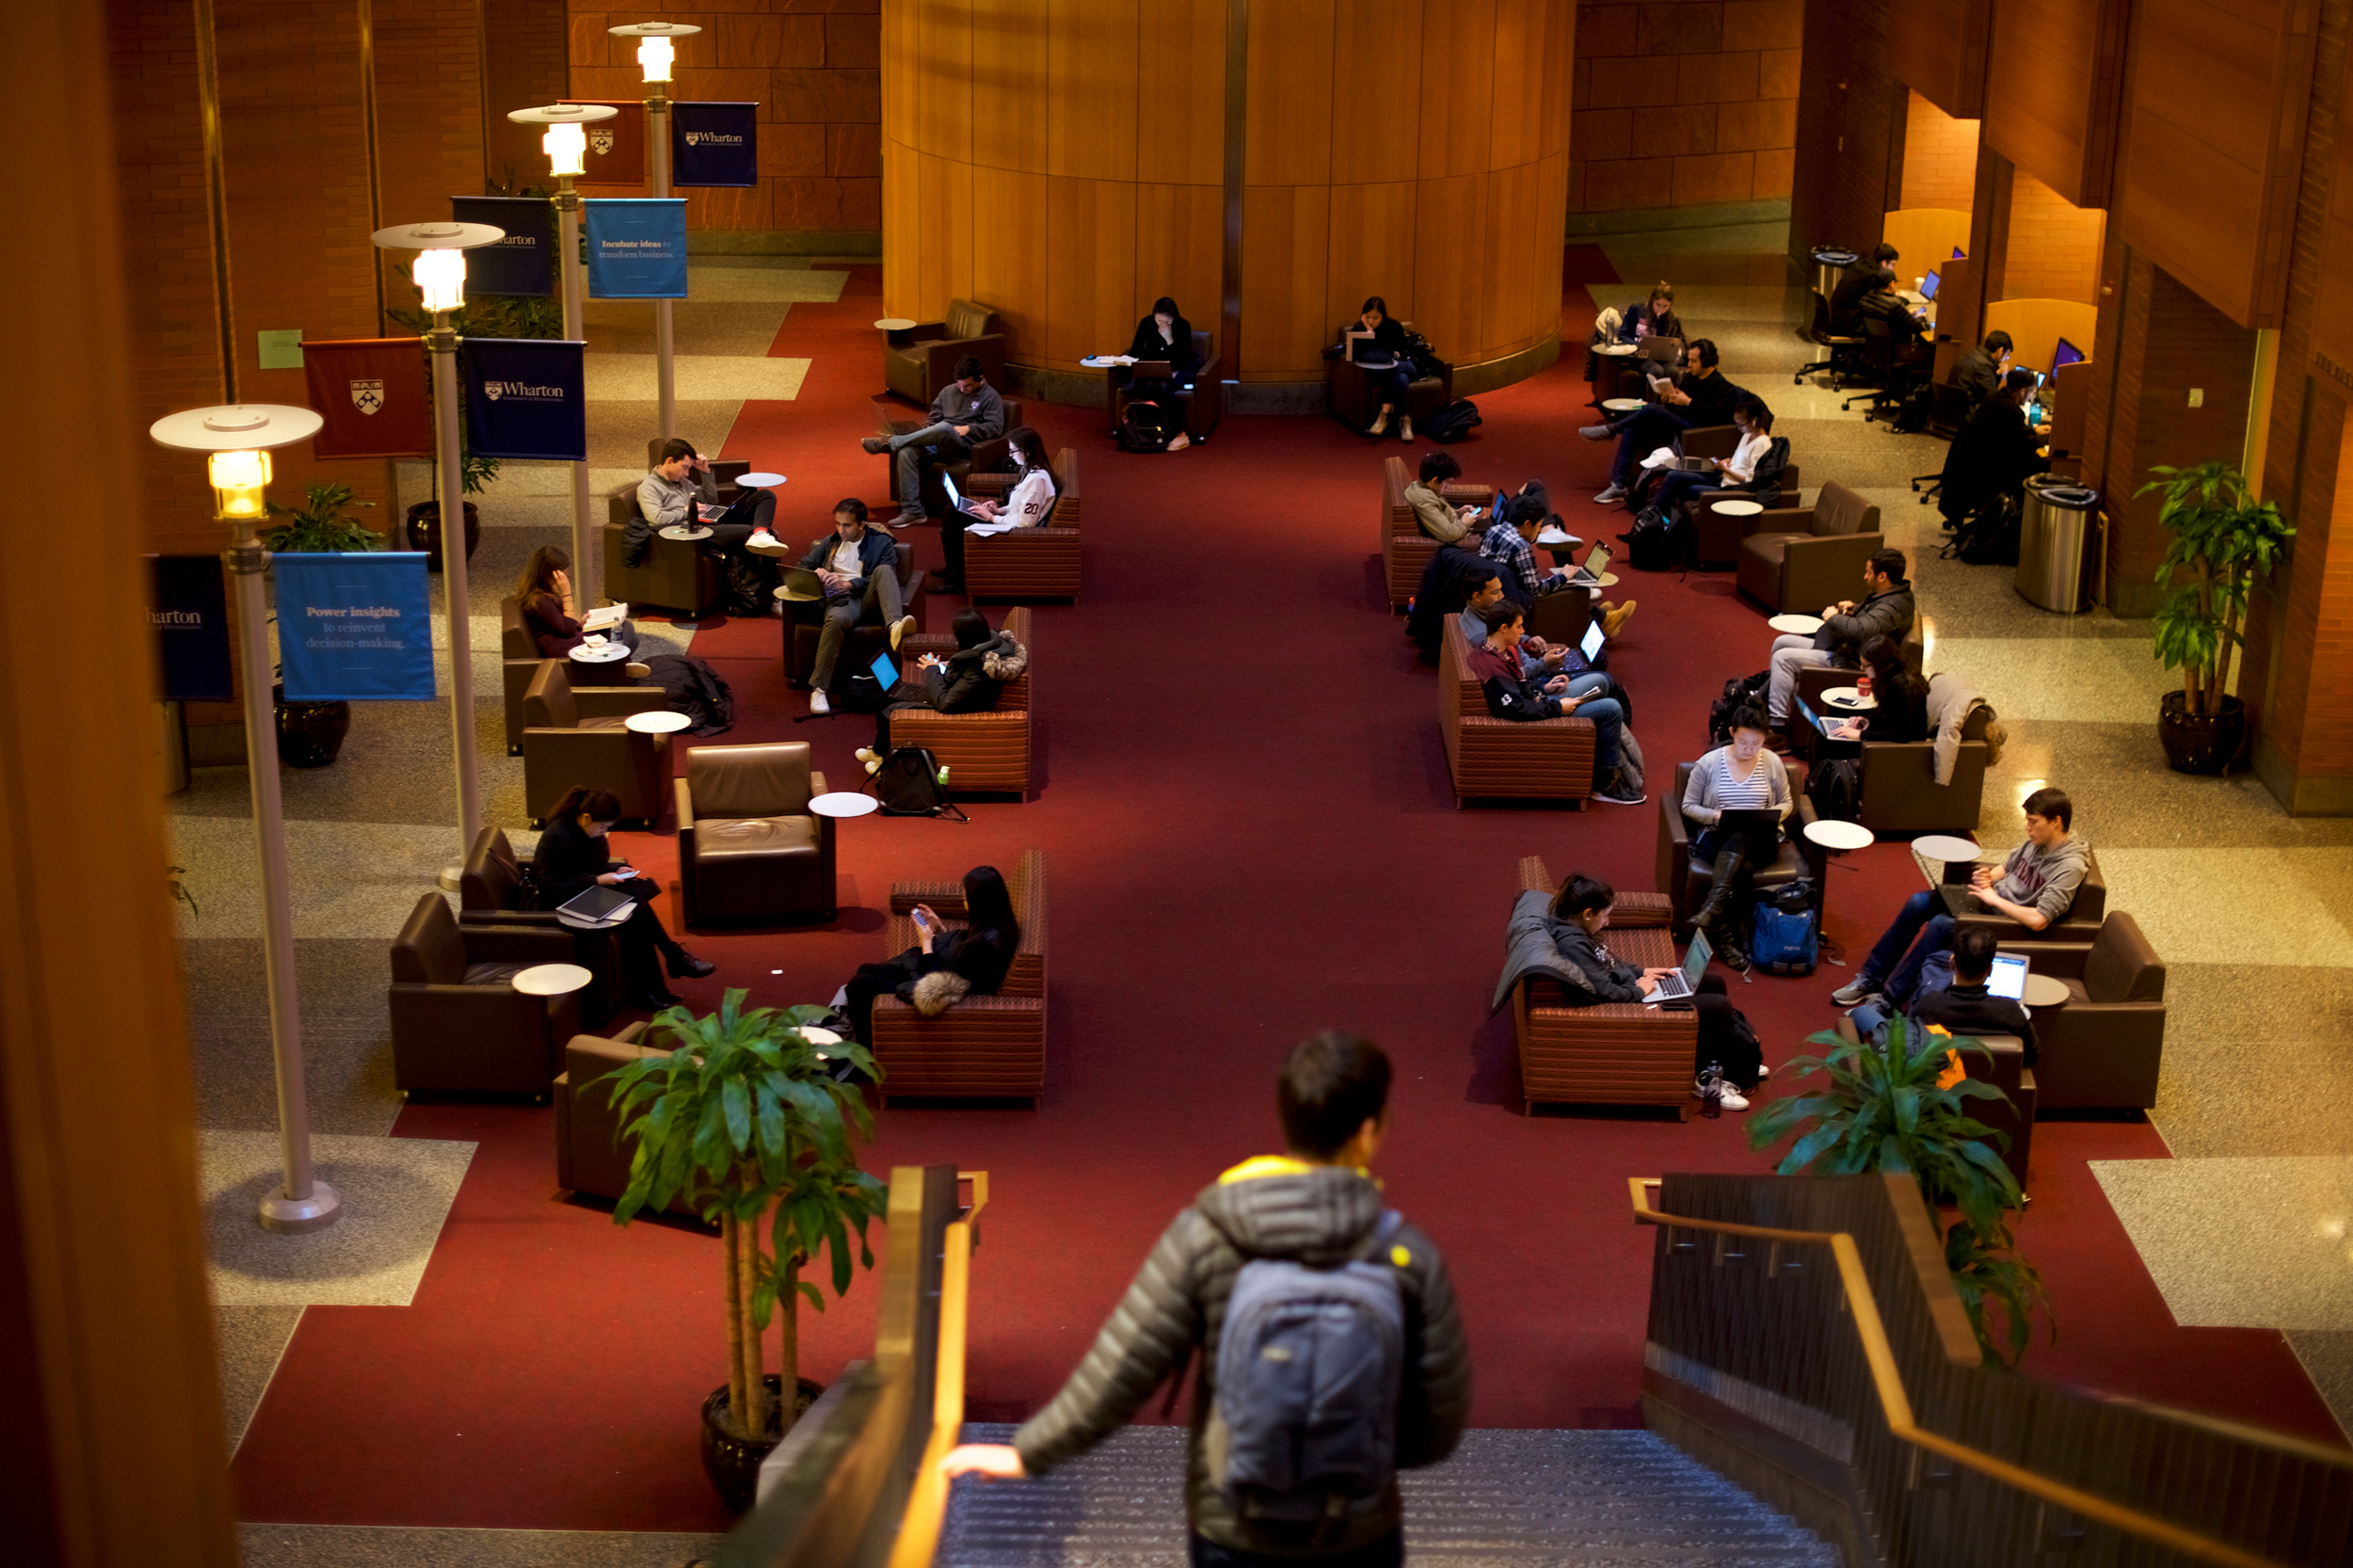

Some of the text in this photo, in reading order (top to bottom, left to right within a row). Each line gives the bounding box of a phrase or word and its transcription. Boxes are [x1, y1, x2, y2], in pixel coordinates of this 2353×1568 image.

[699, 132, 743, 143] Wharton
[599, 250, 675, 259] transform business.
[504, 381, 564, 397] Wharton
[1025, 503, 1039, 515] 20
[143, 606, 201, 624] harton
[306, 606, 401, 618] Power insights
[323, 622, 387, 632] to reinvent
[306, 637, 406, 650] decision-making.
